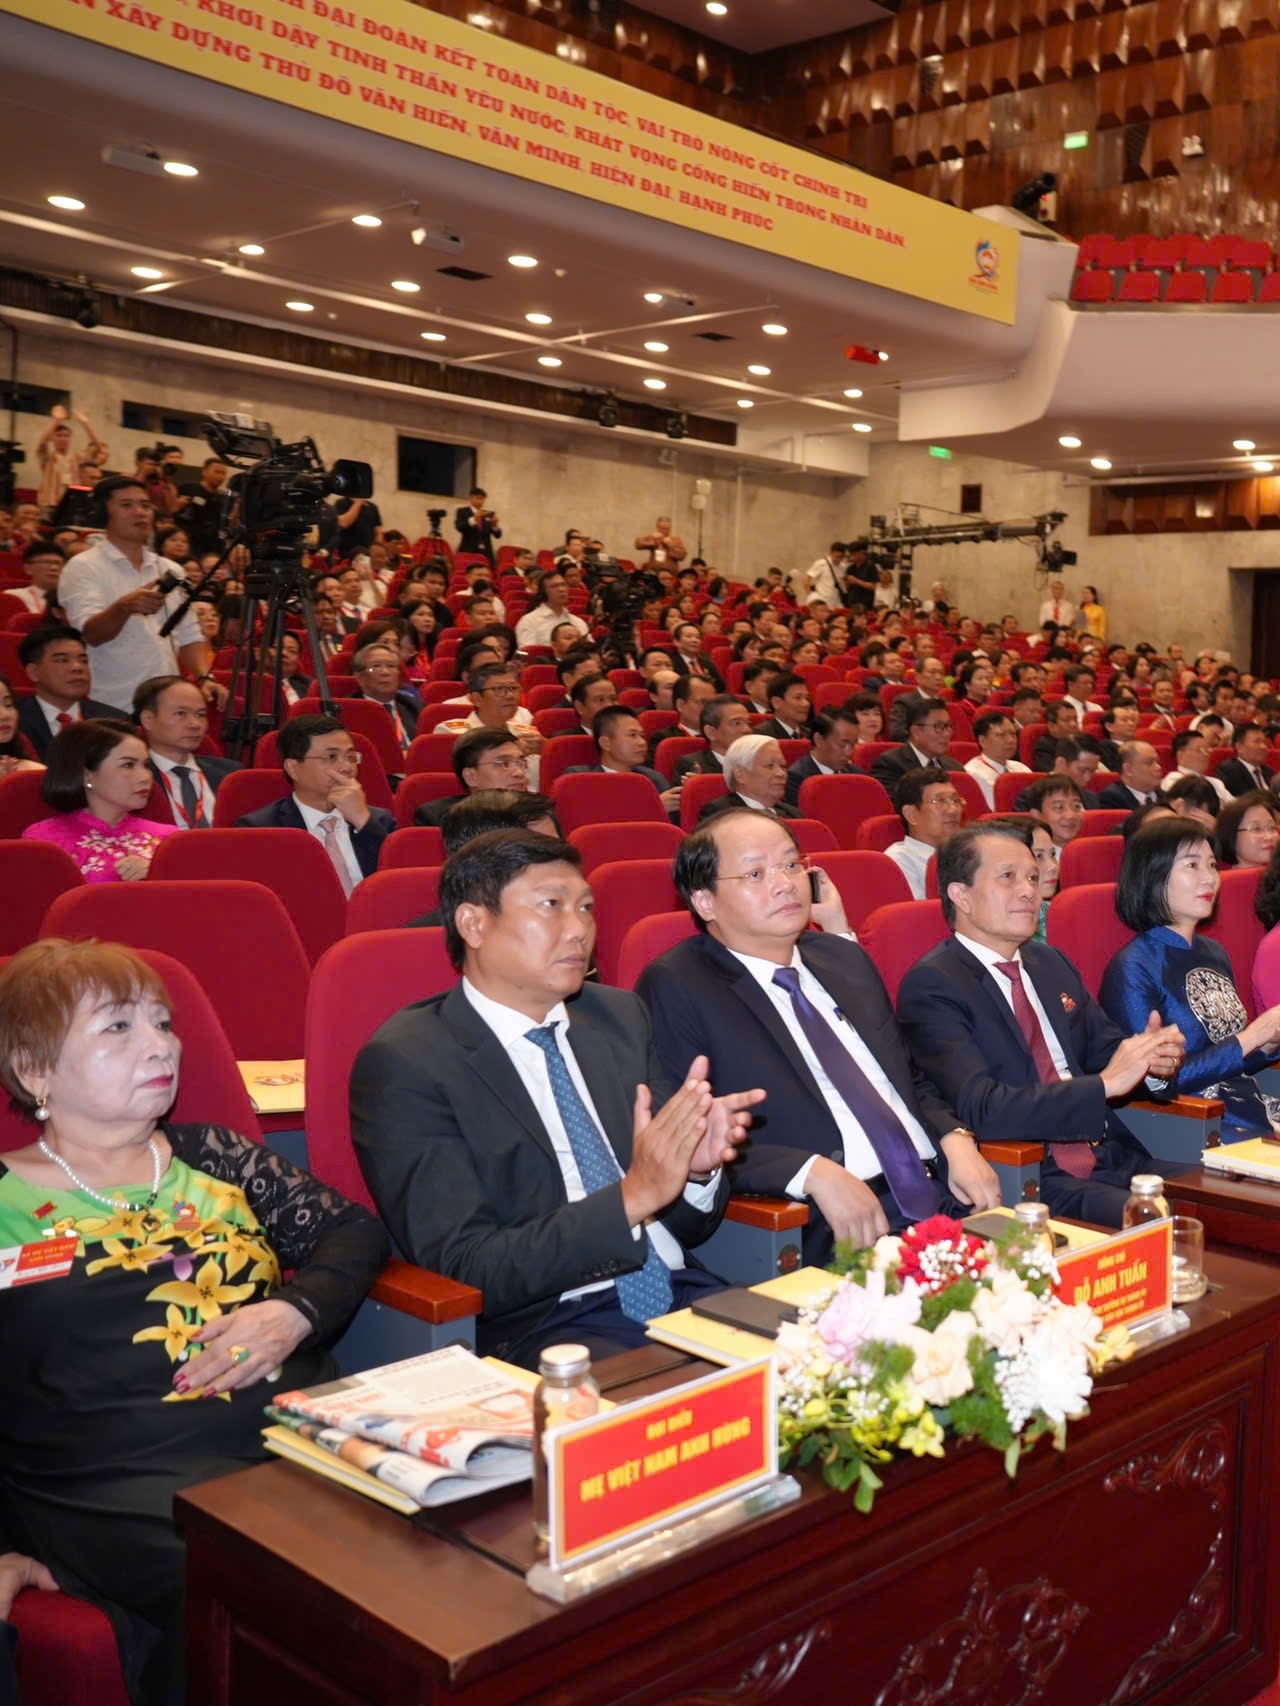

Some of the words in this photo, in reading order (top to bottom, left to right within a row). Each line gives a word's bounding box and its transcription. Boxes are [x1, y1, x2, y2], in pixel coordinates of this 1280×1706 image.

[106, 0, 163, 31] XÂY
[171, 21, 251, 63] DỰNG
[259, 52, 311, 82] THỦ
[319, 71, 352, 96] ĐÔ
[327, 39, 388, 74] TINH
[464, 87, 504, 113] YÊU
[363, 18, 427, 54] ĐOÀN
[484, 62, 540, 94] TOÀN
[546, 84, 586, 111] DÂN
[637, 116, 665, 138] VAI
[1093, 1272, 1117, 1299] ANH
[1119, 1257, 1147, 1289] TUẤN
[607, 1458, 641, 1491] VIỆT
[643, 1445, 678, 1477] NAM
